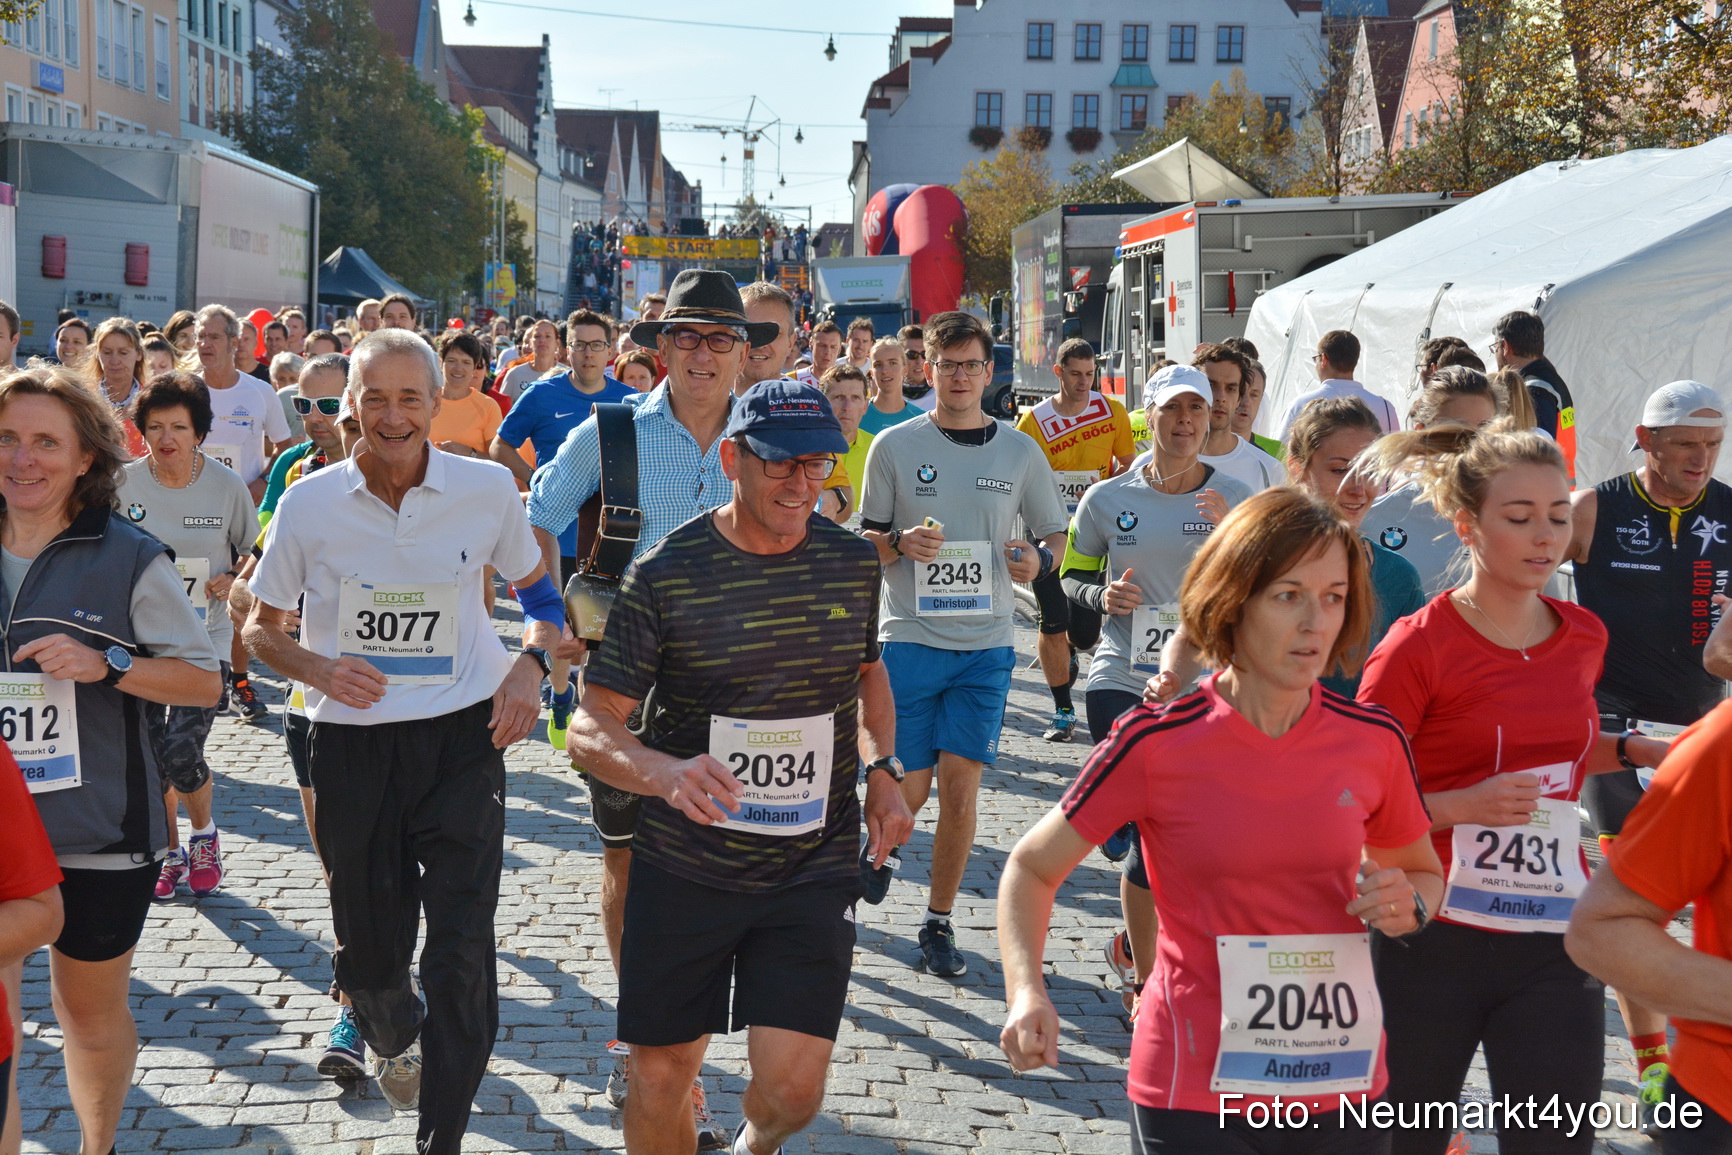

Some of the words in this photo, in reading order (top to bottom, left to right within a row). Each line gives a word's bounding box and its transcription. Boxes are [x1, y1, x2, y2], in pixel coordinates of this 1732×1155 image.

[667, 242, 715, 253] START
[841, 280, 883, 288] BOCK
[1049, 435, 1079, 456] MAX
[1081, 422, 1116, 441] BÖGL
[976, 477, 1013, 492] BOCK
[183, 517, 223, 526] BOCK
[927, 562, 982, 585] 2343
[1692, 560, 1712, 595] ROTH
[374, 592, 424, 603] BOCK
[933, 598, 977, 609] Christoph
[1692, 600, 1708, 616] 08
[1159, 613, 1181, 621] BO
[356, 610, 440, 641] 3077
[1692, 622, 1708, 645] TSG
[0, 683, 46, 696] BOCK
[0, 705, 60, 742] 612
[748, 730, 802, 743] BOCK
[728, 751, 816, 787] 2034
[744, 807, 799, 822] Johann
[1474, 830, 1562, 876] 2431
[1482, 877, 1510, 887] PARTL
[1512, 881, 1552, 891] Neumarkt
[1488, 897, 1546, 916] Annika
[1268, 951, 1336, 968] BOCK
[1247, 982, 1358, 1031] 2040
[1254, 1037, 1289, 1047] PARTL
[1292, 1038, 1336, 1048] Neumarkt
[1264, 1058, 1331, 1078] Andrea
